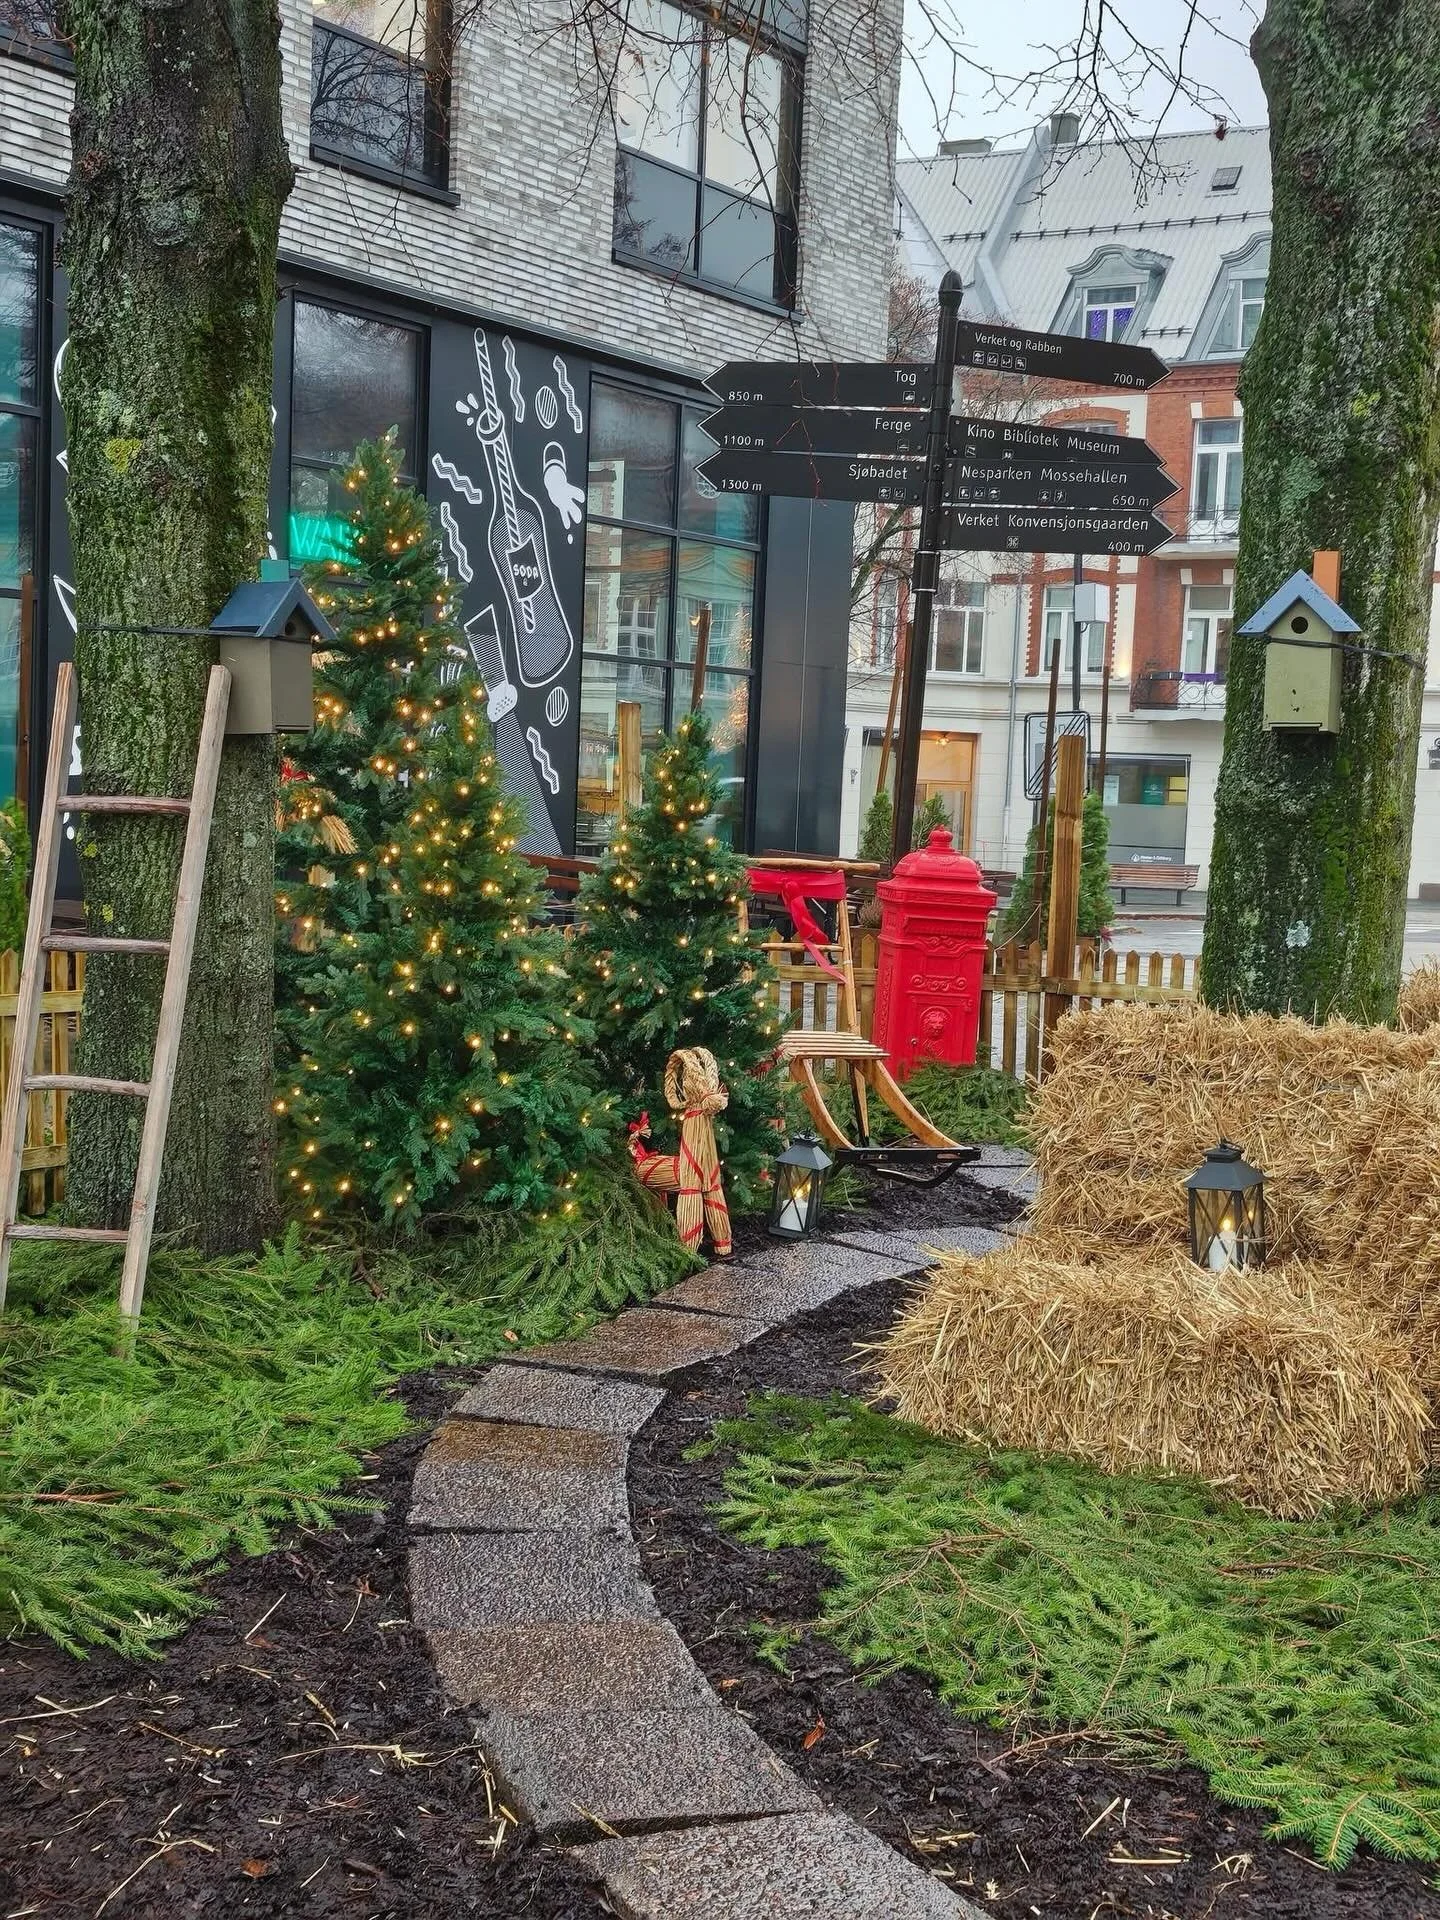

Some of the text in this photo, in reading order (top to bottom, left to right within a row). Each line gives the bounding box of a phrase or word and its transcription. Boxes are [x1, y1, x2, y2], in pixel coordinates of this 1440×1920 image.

[974, 332, 1062, 354] Verket og Rabben
[894, 370, 917, 385] Tog
[1113, 373, 1145, 386] 700 m
[728, 391, 763, 401] 850 m
[875, 418, 912, 433] Ferge
[723, 435, 764, 446] 1100 m
[967, 423, 1120, 454] Kino Bibliotek Museum
[849, 465, 908, 480] Sjøbadet
[961, 465, 1128, 484] Nesparken Mossehallen
[721, 479, 762, 491] 1300 m
[1112, 495, 1149, 506] 650 m
[957, 513, 1149, 531] Verket Konvensjonsgaarden
[1107, 541, 1145, 552] 400 m
[513, 564, 539, 579] SODA
